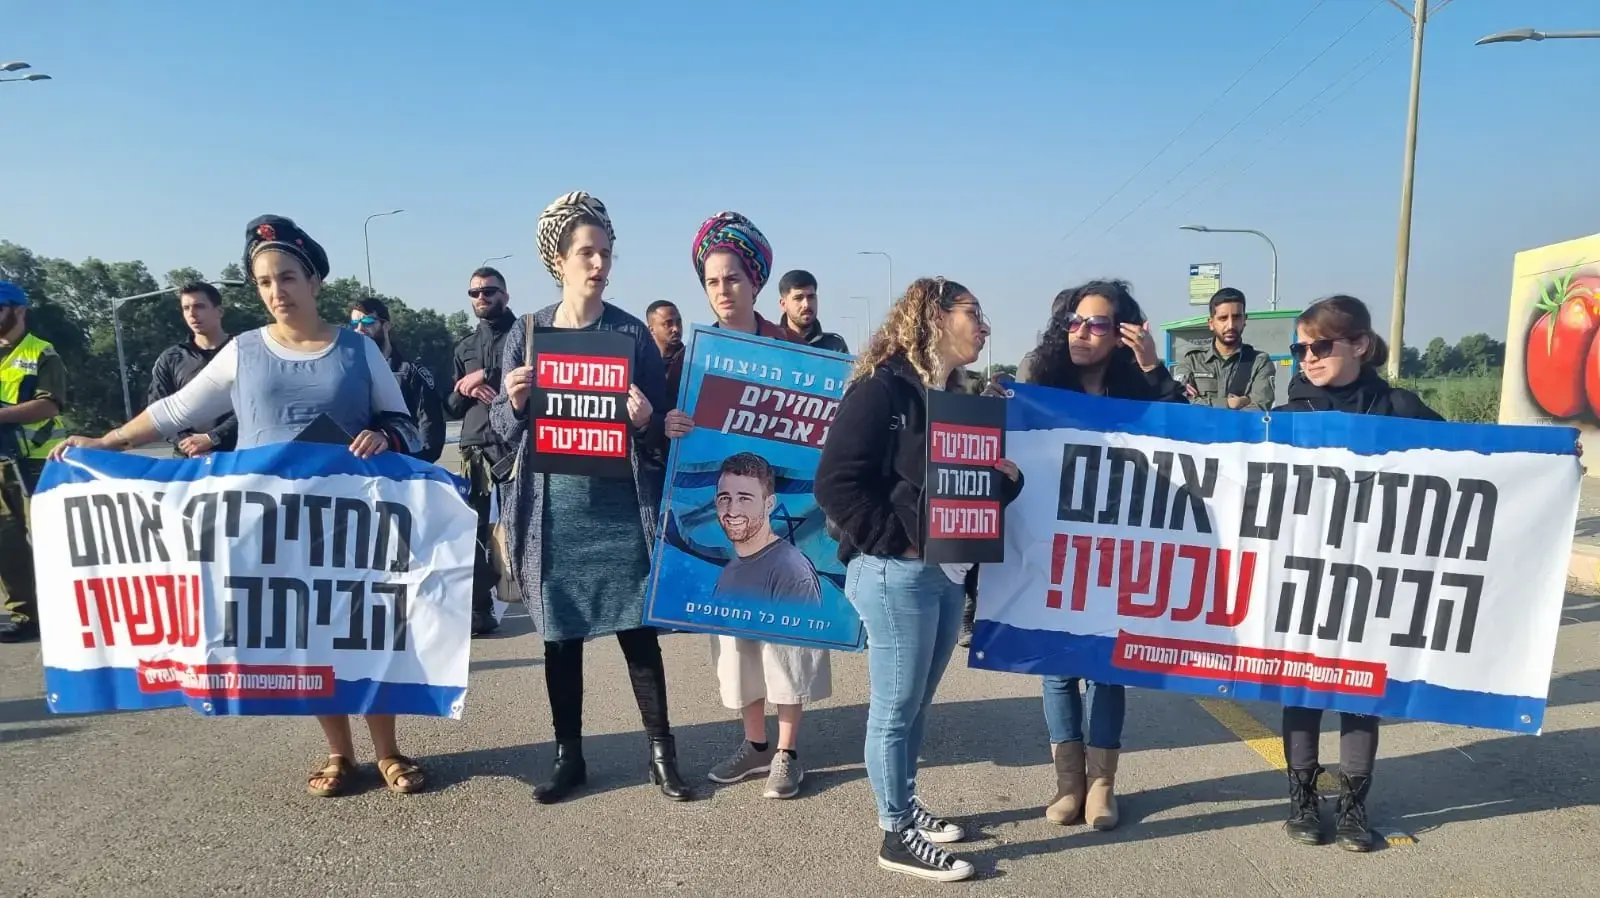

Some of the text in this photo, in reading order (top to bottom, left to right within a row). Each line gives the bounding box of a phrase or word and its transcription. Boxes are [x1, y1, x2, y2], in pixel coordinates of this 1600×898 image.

[540, 360, 625, 388] הומניטרי
[704, 353, 782, 381] הניצחון
[791, 370, 816, 387] עד
[545, 392, 616, 419] תמורת
[739, 385, 840, 421] מחזירים
[539, 425, 623, 453] הומניטרי
[720, 408, 815, 443] אבינתן
[932, 430, 998, 461] הומניטרי
[937, 468, 991, 496] תמורת
[1056, 443, 1498, 562] מחזירים אותם
[64, 490, 412, 573] מחזירים אותם
[931, 506, 997, 534] הומניטרי
[1046, 533, 1485, 653] הביתה עכשיו!
[73, 574, 408, 651] הביתה עכשיו!
[685, 601, 832, 631] יחד עם כל החטופים
[1123, 643, 1374, 688] מטה המשפחות להחזרת החטופים והנעדרים
[237, 673, 296, 689] המשפחות
[298, 674, 323, 690] מטה
